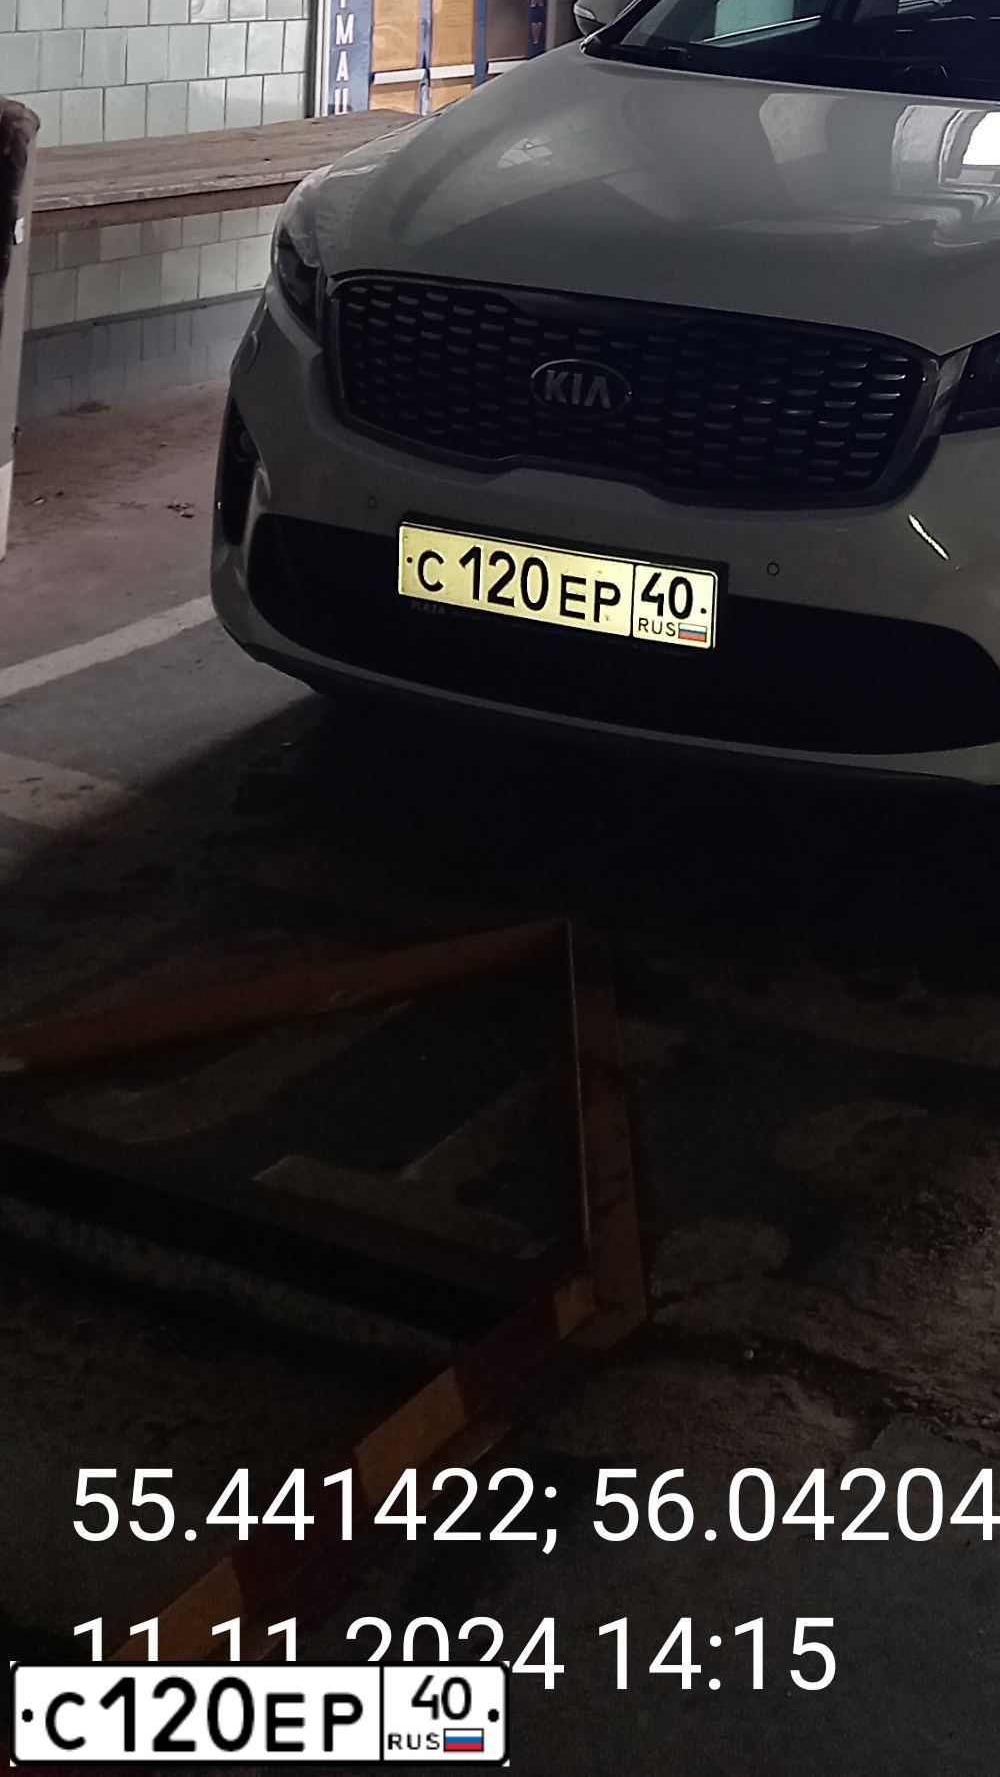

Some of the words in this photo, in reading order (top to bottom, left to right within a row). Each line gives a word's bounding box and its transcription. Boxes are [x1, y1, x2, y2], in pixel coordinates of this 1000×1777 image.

[544, 369, 611, 409] KIA
[640, 572, 693, 620] 40
[638, 617, 677, 638] RUS
